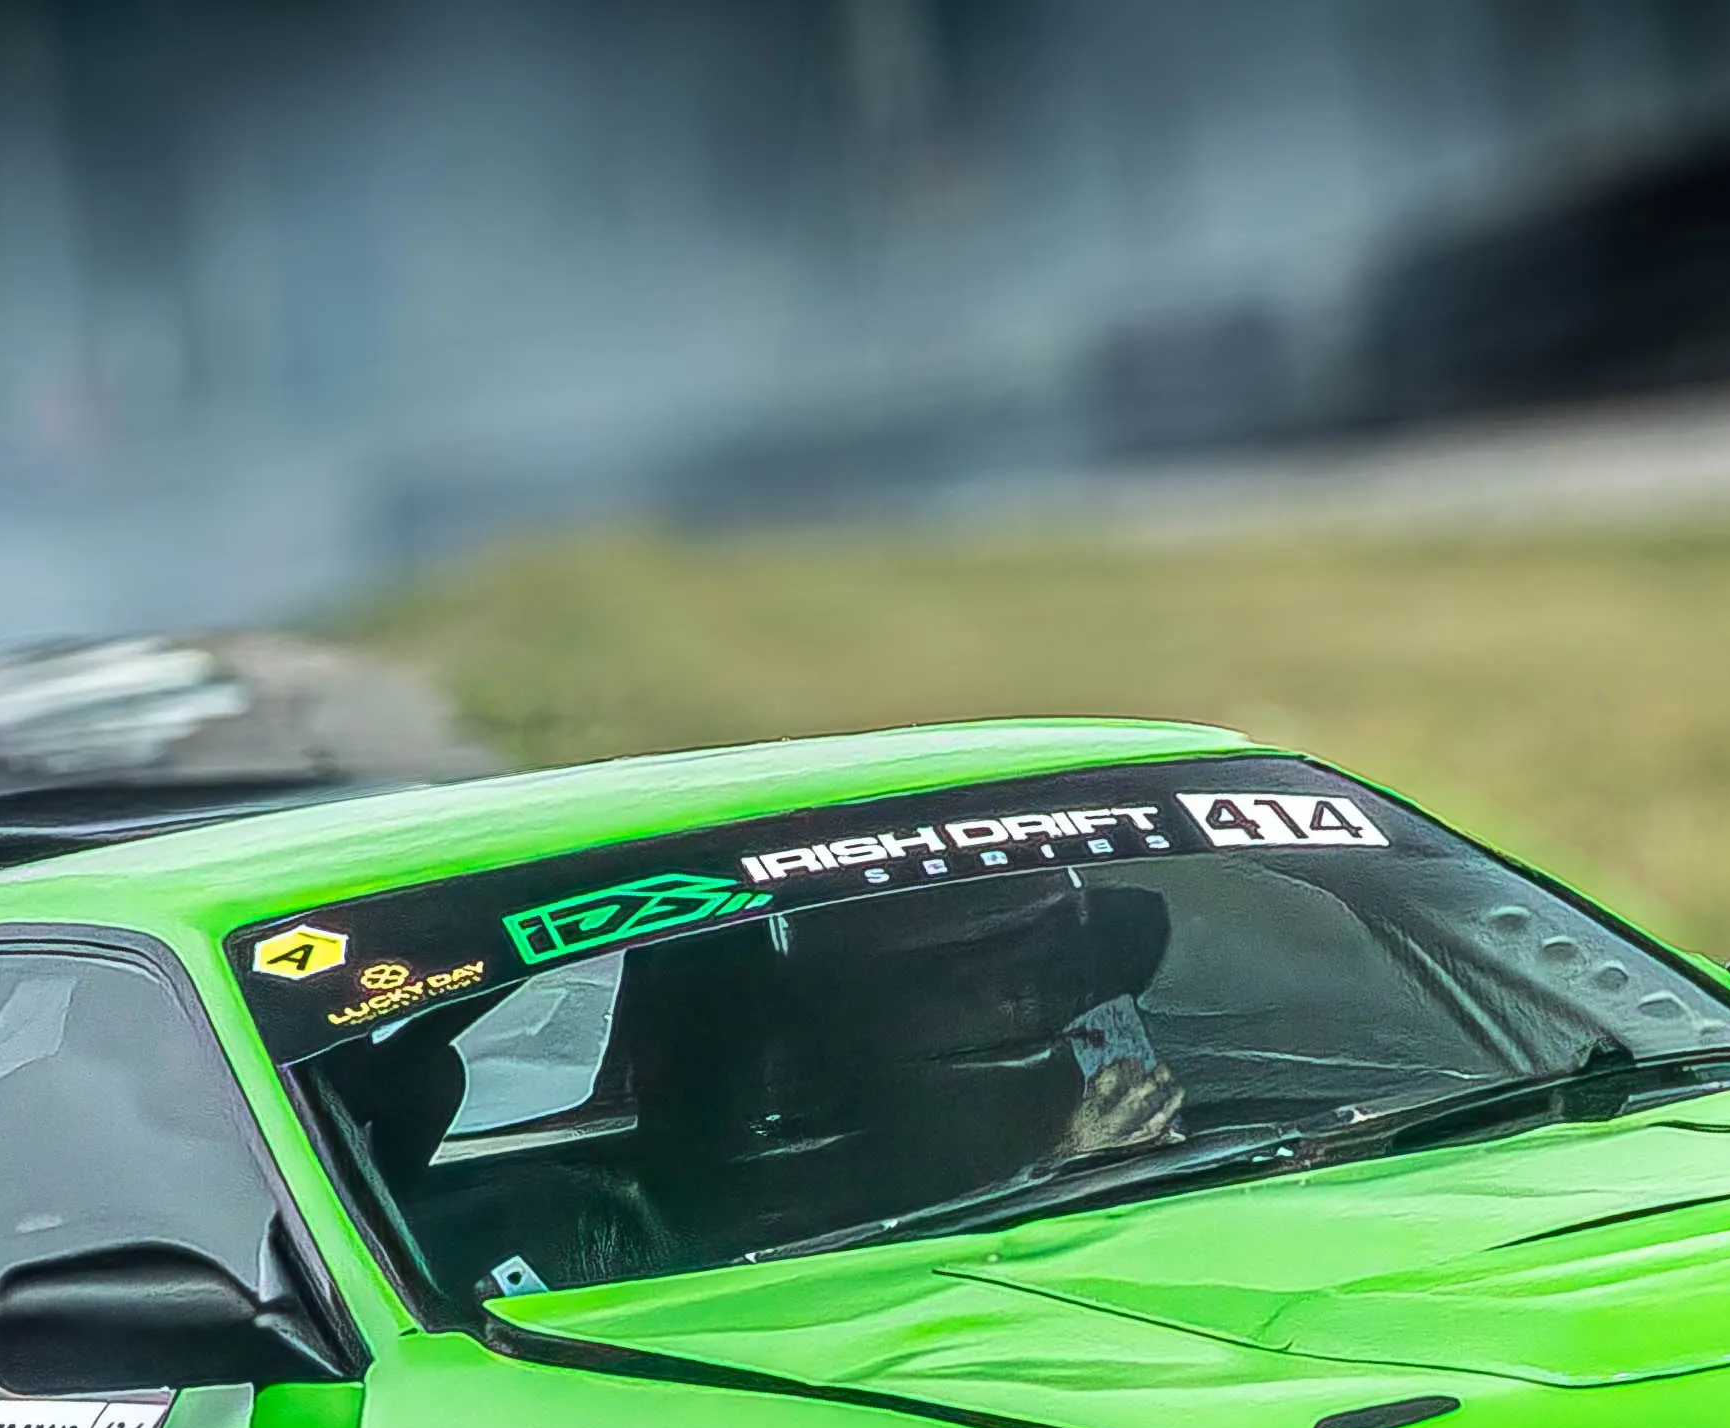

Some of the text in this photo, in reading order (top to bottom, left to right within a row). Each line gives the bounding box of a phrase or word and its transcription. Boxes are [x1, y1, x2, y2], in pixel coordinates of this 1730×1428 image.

[741, 806, 1159, 886] IRISH DRIFT
[1205, 799, 1364, 841] 414
[266, 943, 315, 971] A
[327, 980, 424, 1026] LUCKY
[426, 960, 485, 989] DAY
